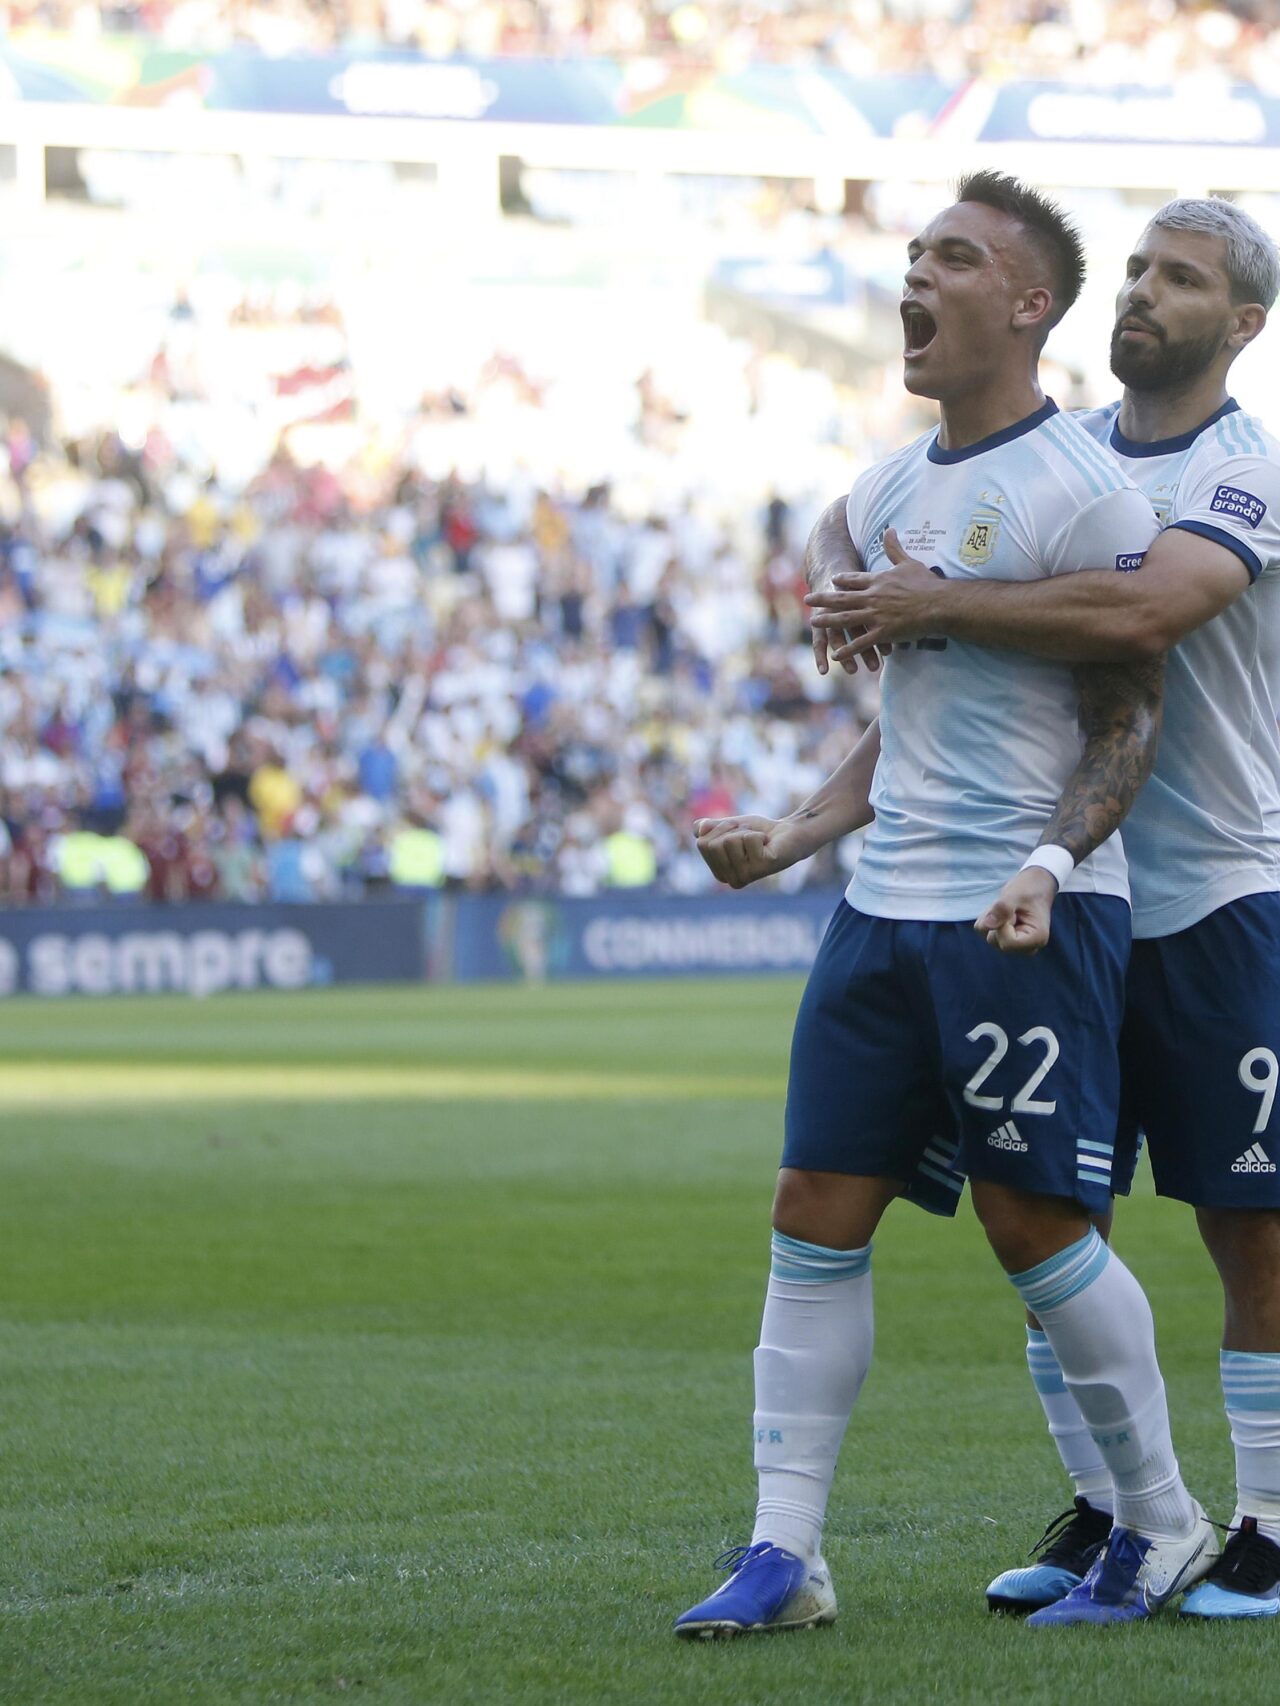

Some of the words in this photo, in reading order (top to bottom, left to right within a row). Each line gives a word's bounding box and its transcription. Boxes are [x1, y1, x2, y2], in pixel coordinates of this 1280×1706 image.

[1212, 499, 1258, 522] grande
[1218, 488, 1248, 504] Cree
[1249, 500, 1263, 514] en
[962, 1021, 1060, 1116] 22
[1237, 1046, 1280, 1134] 9
[987, 1136, 1029, 1153] adidas
[1230, 1161, 1277, 1173] adidas
